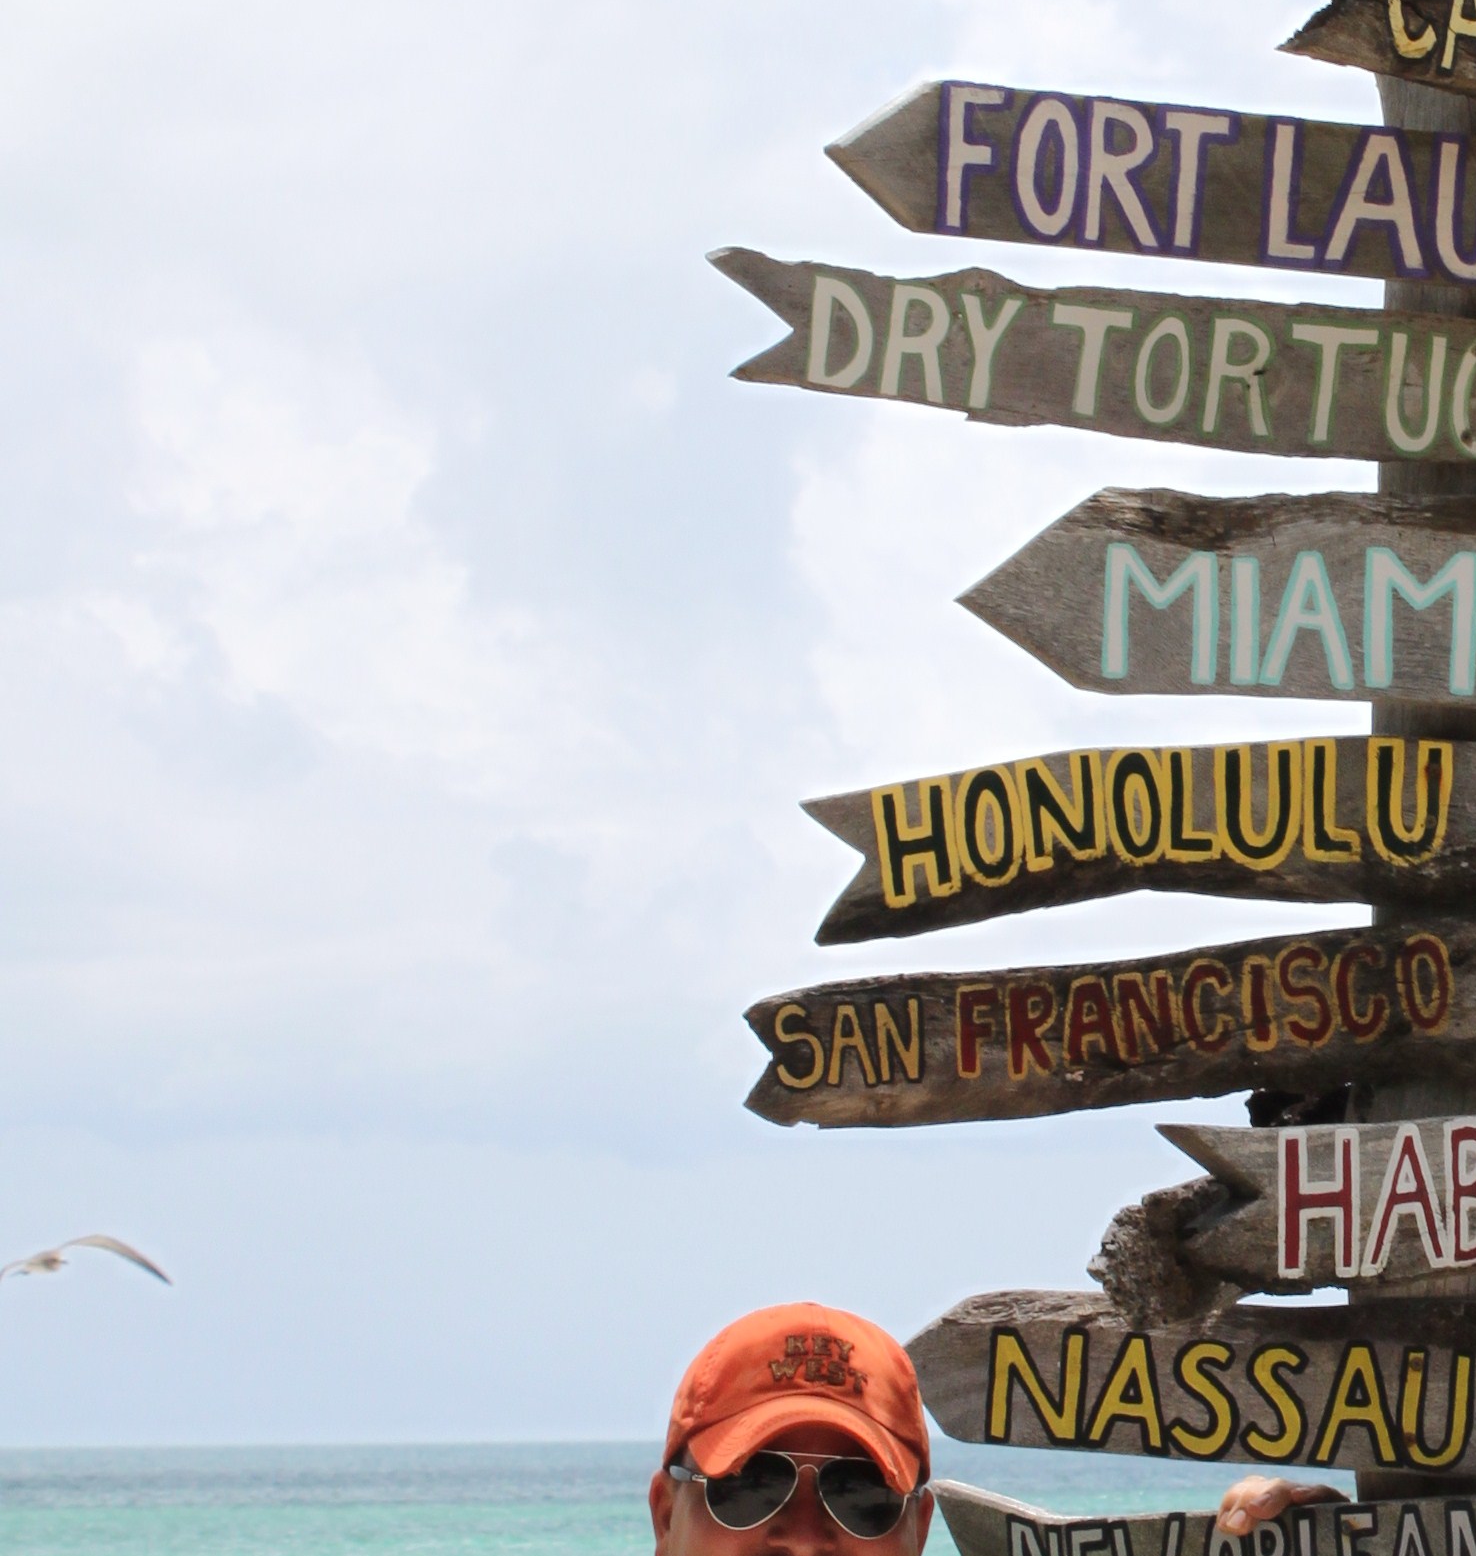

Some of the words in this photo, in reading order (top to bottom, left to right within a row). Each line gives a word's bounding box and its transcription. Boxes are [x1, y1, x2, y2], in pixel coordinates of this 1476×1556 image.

[936, 83, 1242, 258] FORT
[802, 273, 1027, 413] DRY
[871, 736, 1455, 907] HONOLULU
[774, 996, 924, 1092] SAN
[955, 932, 1454, 1081] FRANCISCO
[768, 1357, 868, 1395] WEST
[785, 1334, 854, 1362] KEY
[987, 1327, 1474, 1469] NASSAU
